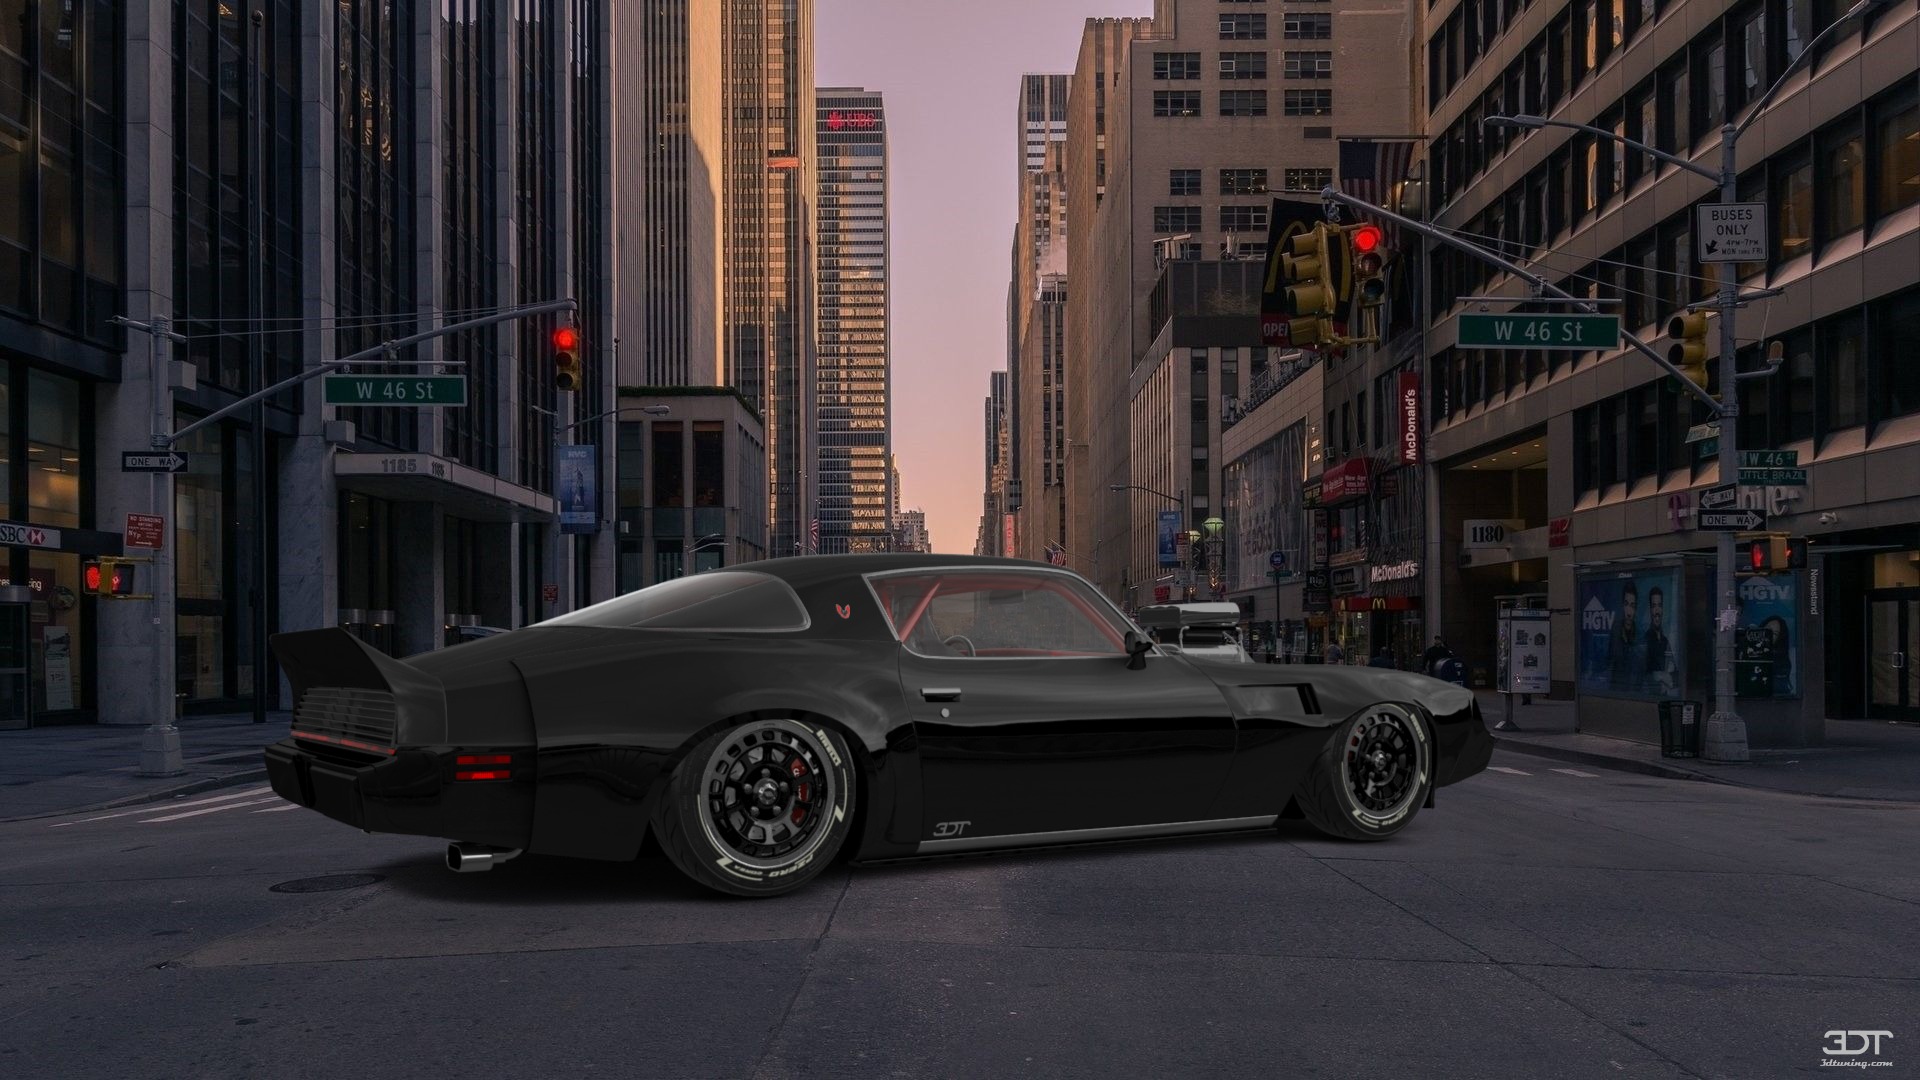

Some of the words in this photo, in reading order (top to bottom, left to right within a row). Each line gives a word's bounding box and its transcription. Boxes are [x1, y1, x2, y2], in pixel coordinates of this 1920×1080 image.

[847, 112, 876, 127] UBS
[1711, 209, 1752, 221] BUSES
[1716, 224, 1748, 235] ONLY
[1494, 320, 1513, 341] W
[1524, 321, 1551, 342] 46
[1561, 321, 1583, 342] St
[356, 381, 373, 399] W
[383, 381, 406, 400] 46
[415, 381, 434, 400] St
[1405, 388, 1416, 460] McDonald's
[130, 457, 150, 466] ONE
[158, 457, 177, 466] WAY
[381, 458, 417, 472] 1185
[1749, 452, 1760, 465] W
[1766, 453, 1784, 465] 46
[1739, 470, 1768, 480] LITTLE
[1772, 470, 1805, 480] BRAZIL
[1707, 516, 1727, 525] ONE
[1736, 516, 1756, 525] WAY
[0, 526, 26, 543] SBC
[1472, 525, 1504, 543] 1180
[1371, 560, 1419, 583] McDonald's
[1740, 585, 1791, 600] HGTV
[1810, 569, 1818, 615] Newsstand
[1583, 610, 1615, 630] HGTV
[933, 820, 972, 837] 3DT
